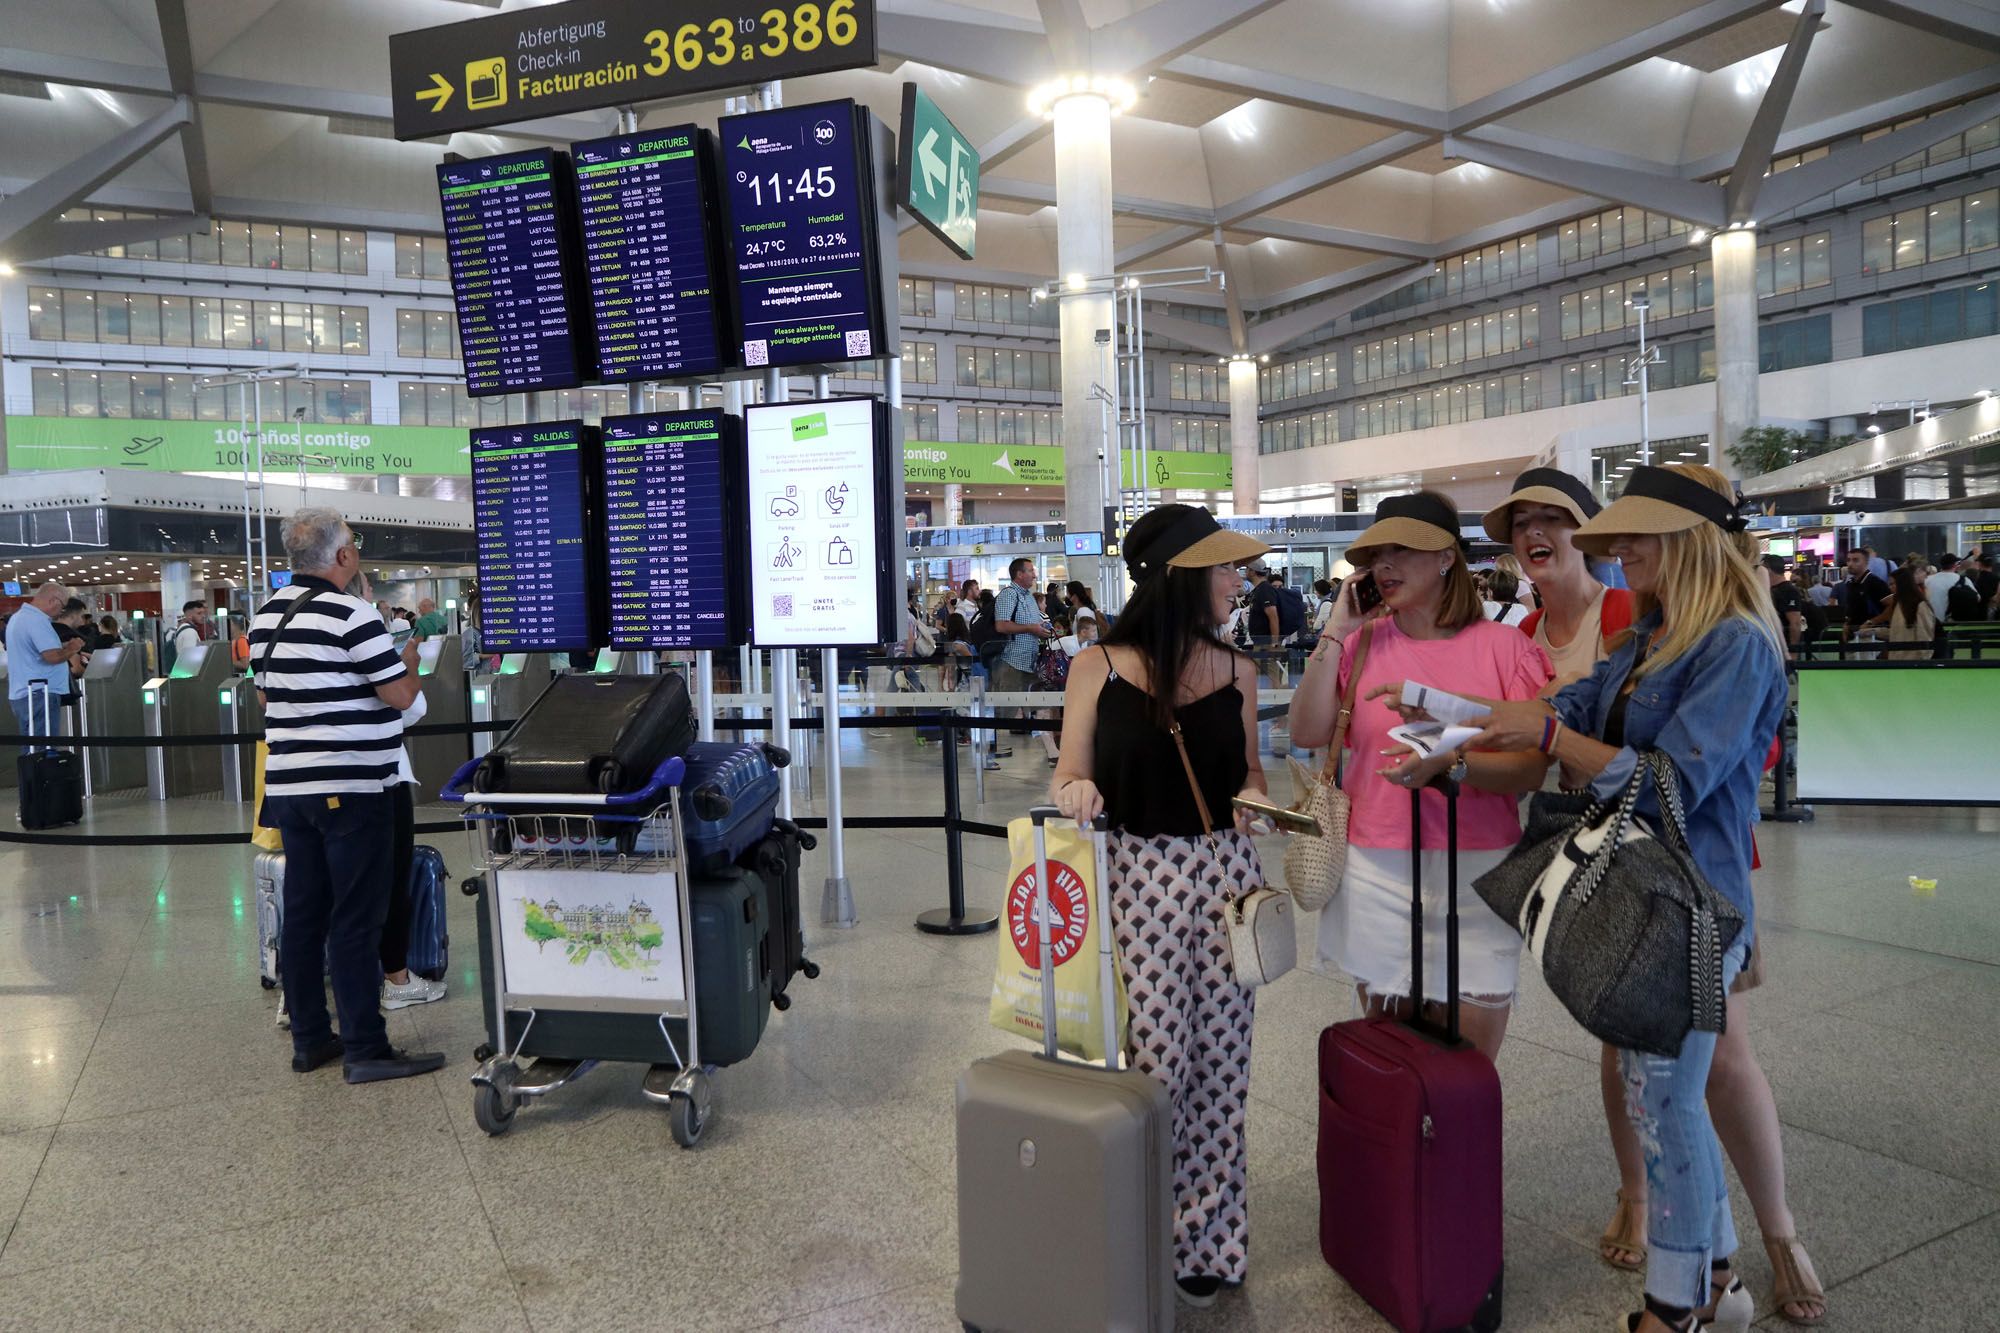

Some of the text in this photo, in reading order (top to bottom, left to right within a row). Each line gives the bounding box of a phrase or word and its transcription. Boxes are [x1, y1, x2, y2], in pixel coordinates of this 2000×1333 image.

[739, 16, 755, 34] to
[742, 0, 858, 62] a 386
[518, 19, 606, 50] Abfertigung
[518, 48, 581, 73] Check-in
[519, 18, 735, 99] Facturación 363
[815, 126, 833, 139] 100
[638, 136, 688, 152] DEPARTURES
[751, 137, 767, 145] aena
[498, 159, 544, 175] DEPARTURES
[747, 165, 836, 206] 11:45
[524, 190, 550, 199] BOARDING
[592, 192, 612, 201] MADRID
[593, 203, 619, 212] ASTURIAS
[527, 213, 554, 222] CANCELLED
[740, 212, 844, 233] Temperatura Humedad
[596, 227, 624, 236] CASABLANCA
[745, 241, 770, 256] 24,7
[809, 234, 834, 249] 63,2
[462, 258, 487, 266] GLASGOW
[826, 251, 860, 260] noviembre
[533, 260, 559, 268] EMBARQUE
[602, 274, 629, 282] FRANKFURT
[767, 280, 833, 295] Mantenga siempre
[537, 294, 563, 303] BOARDING
[770, 295, 801, 306] equipaje
[802, 290, 841, 301] controlado
[540, 317, 566, 325] EMBARQUE
[796, 324, 818, 334] always
[819, 323, 835, 331] keep
[770, 332, 841, 346] your luggage attended
[665, 419, 714, 431] DEPARTURES
[215, 429, 251, 444] 100
[305, 431, 370, 450] contigo
[216, 451, 250, 465] 100
[382, 454, 412, 467] You
[1014, 459, 1036, 467] aena
[949, 466, 970, 478] You
[1054, 870, 1085, 957] HINOJOSA
